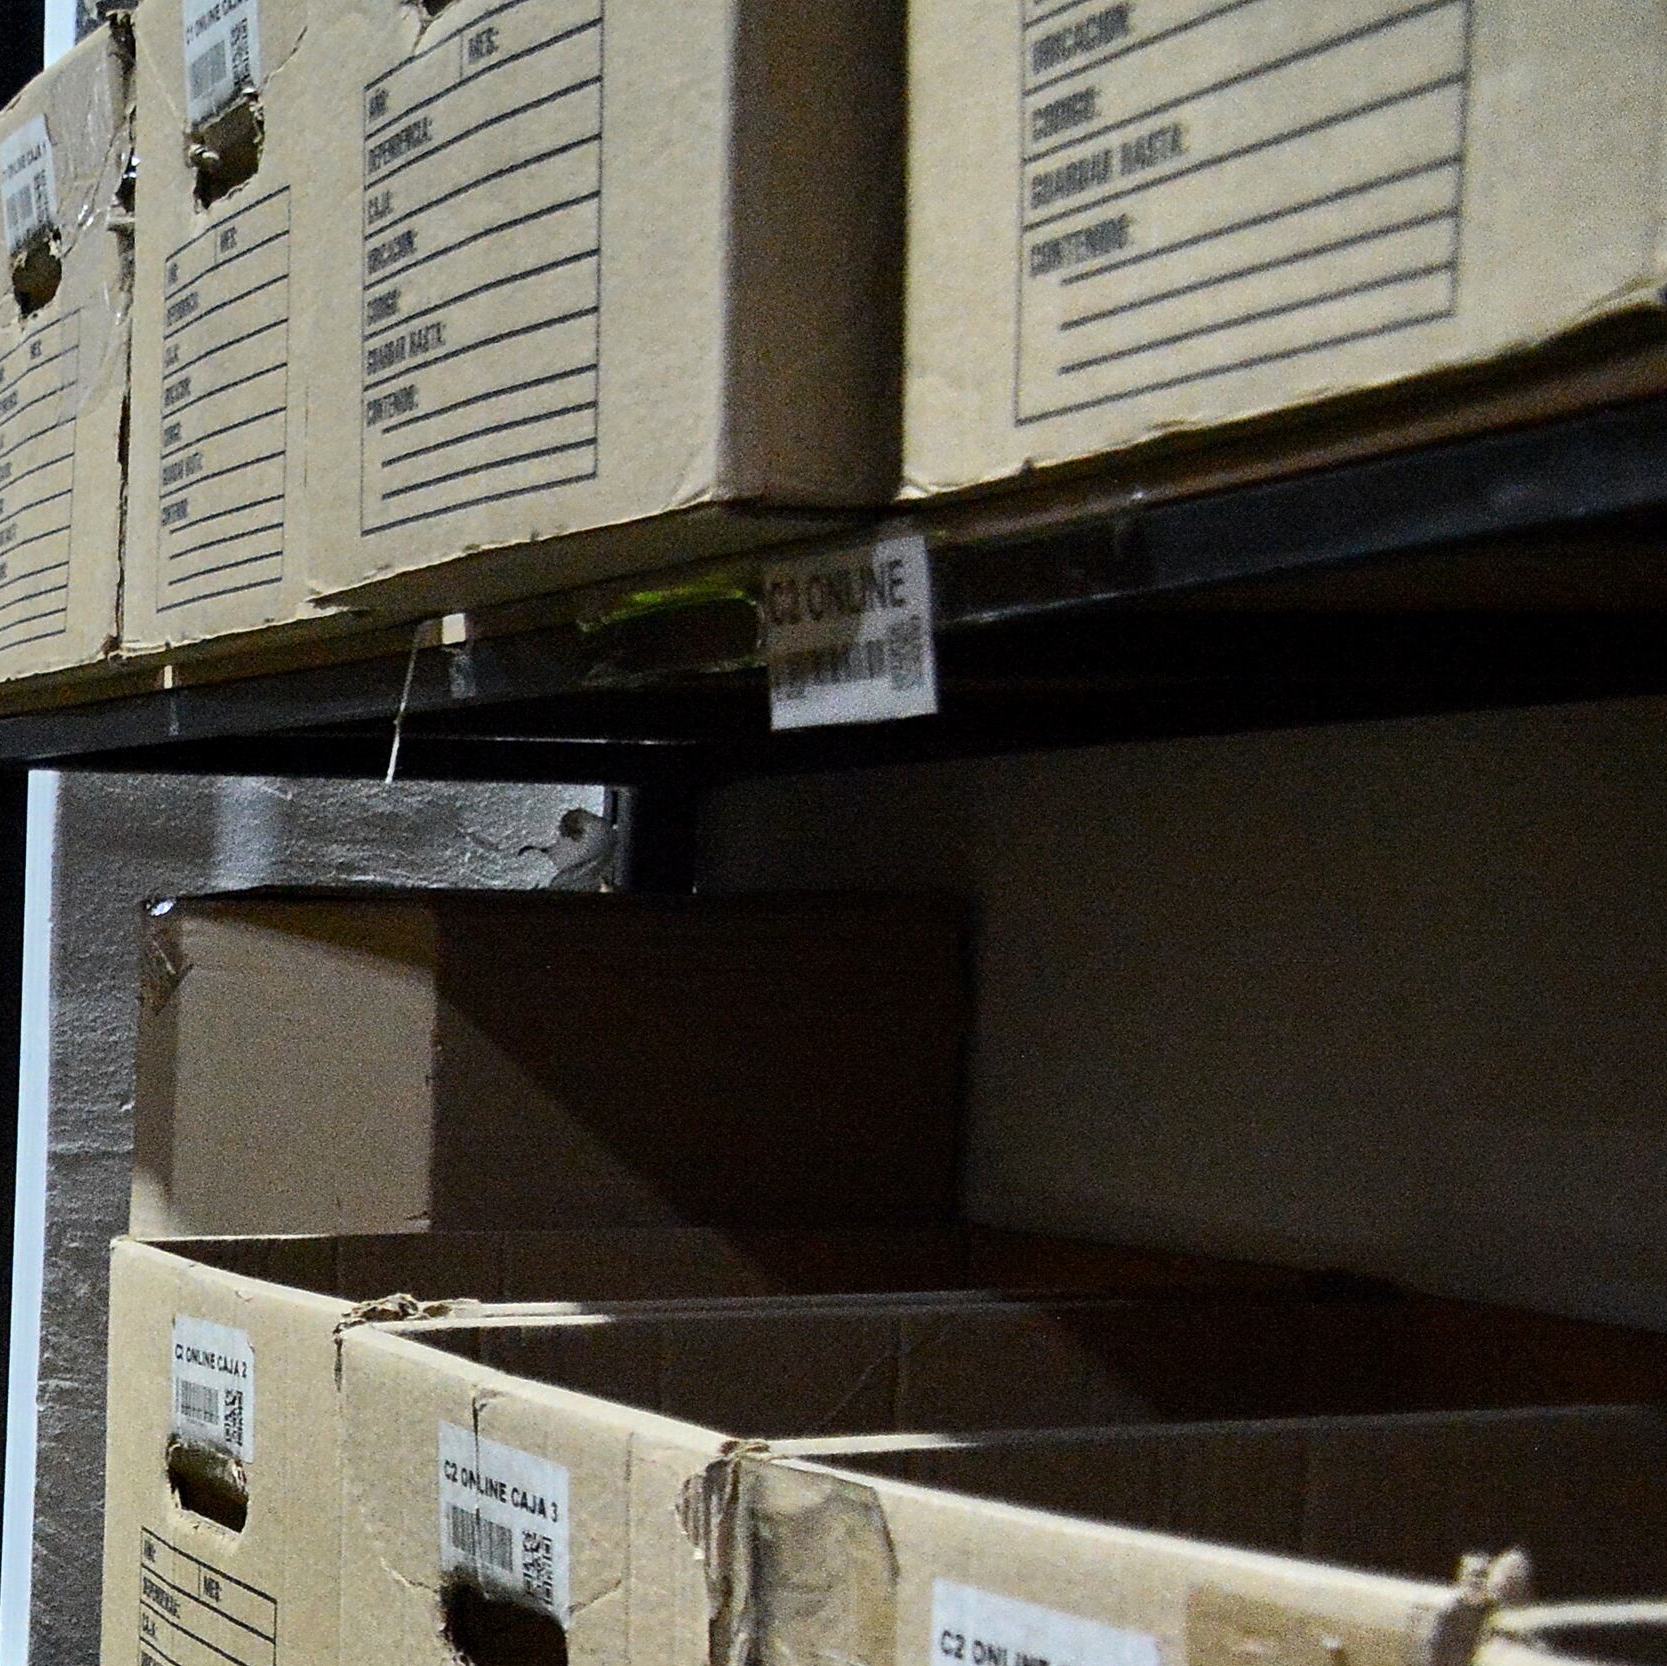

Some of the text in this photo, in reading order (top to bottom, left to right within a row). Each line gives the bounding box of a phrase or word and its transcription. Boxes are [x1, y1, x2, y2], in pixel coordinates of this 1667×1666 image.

[461, 1466, 508, 1504] ONLINE
[510, 1486, 548, 1520] CAJA
[940, 1630, 966, 1660] C2
